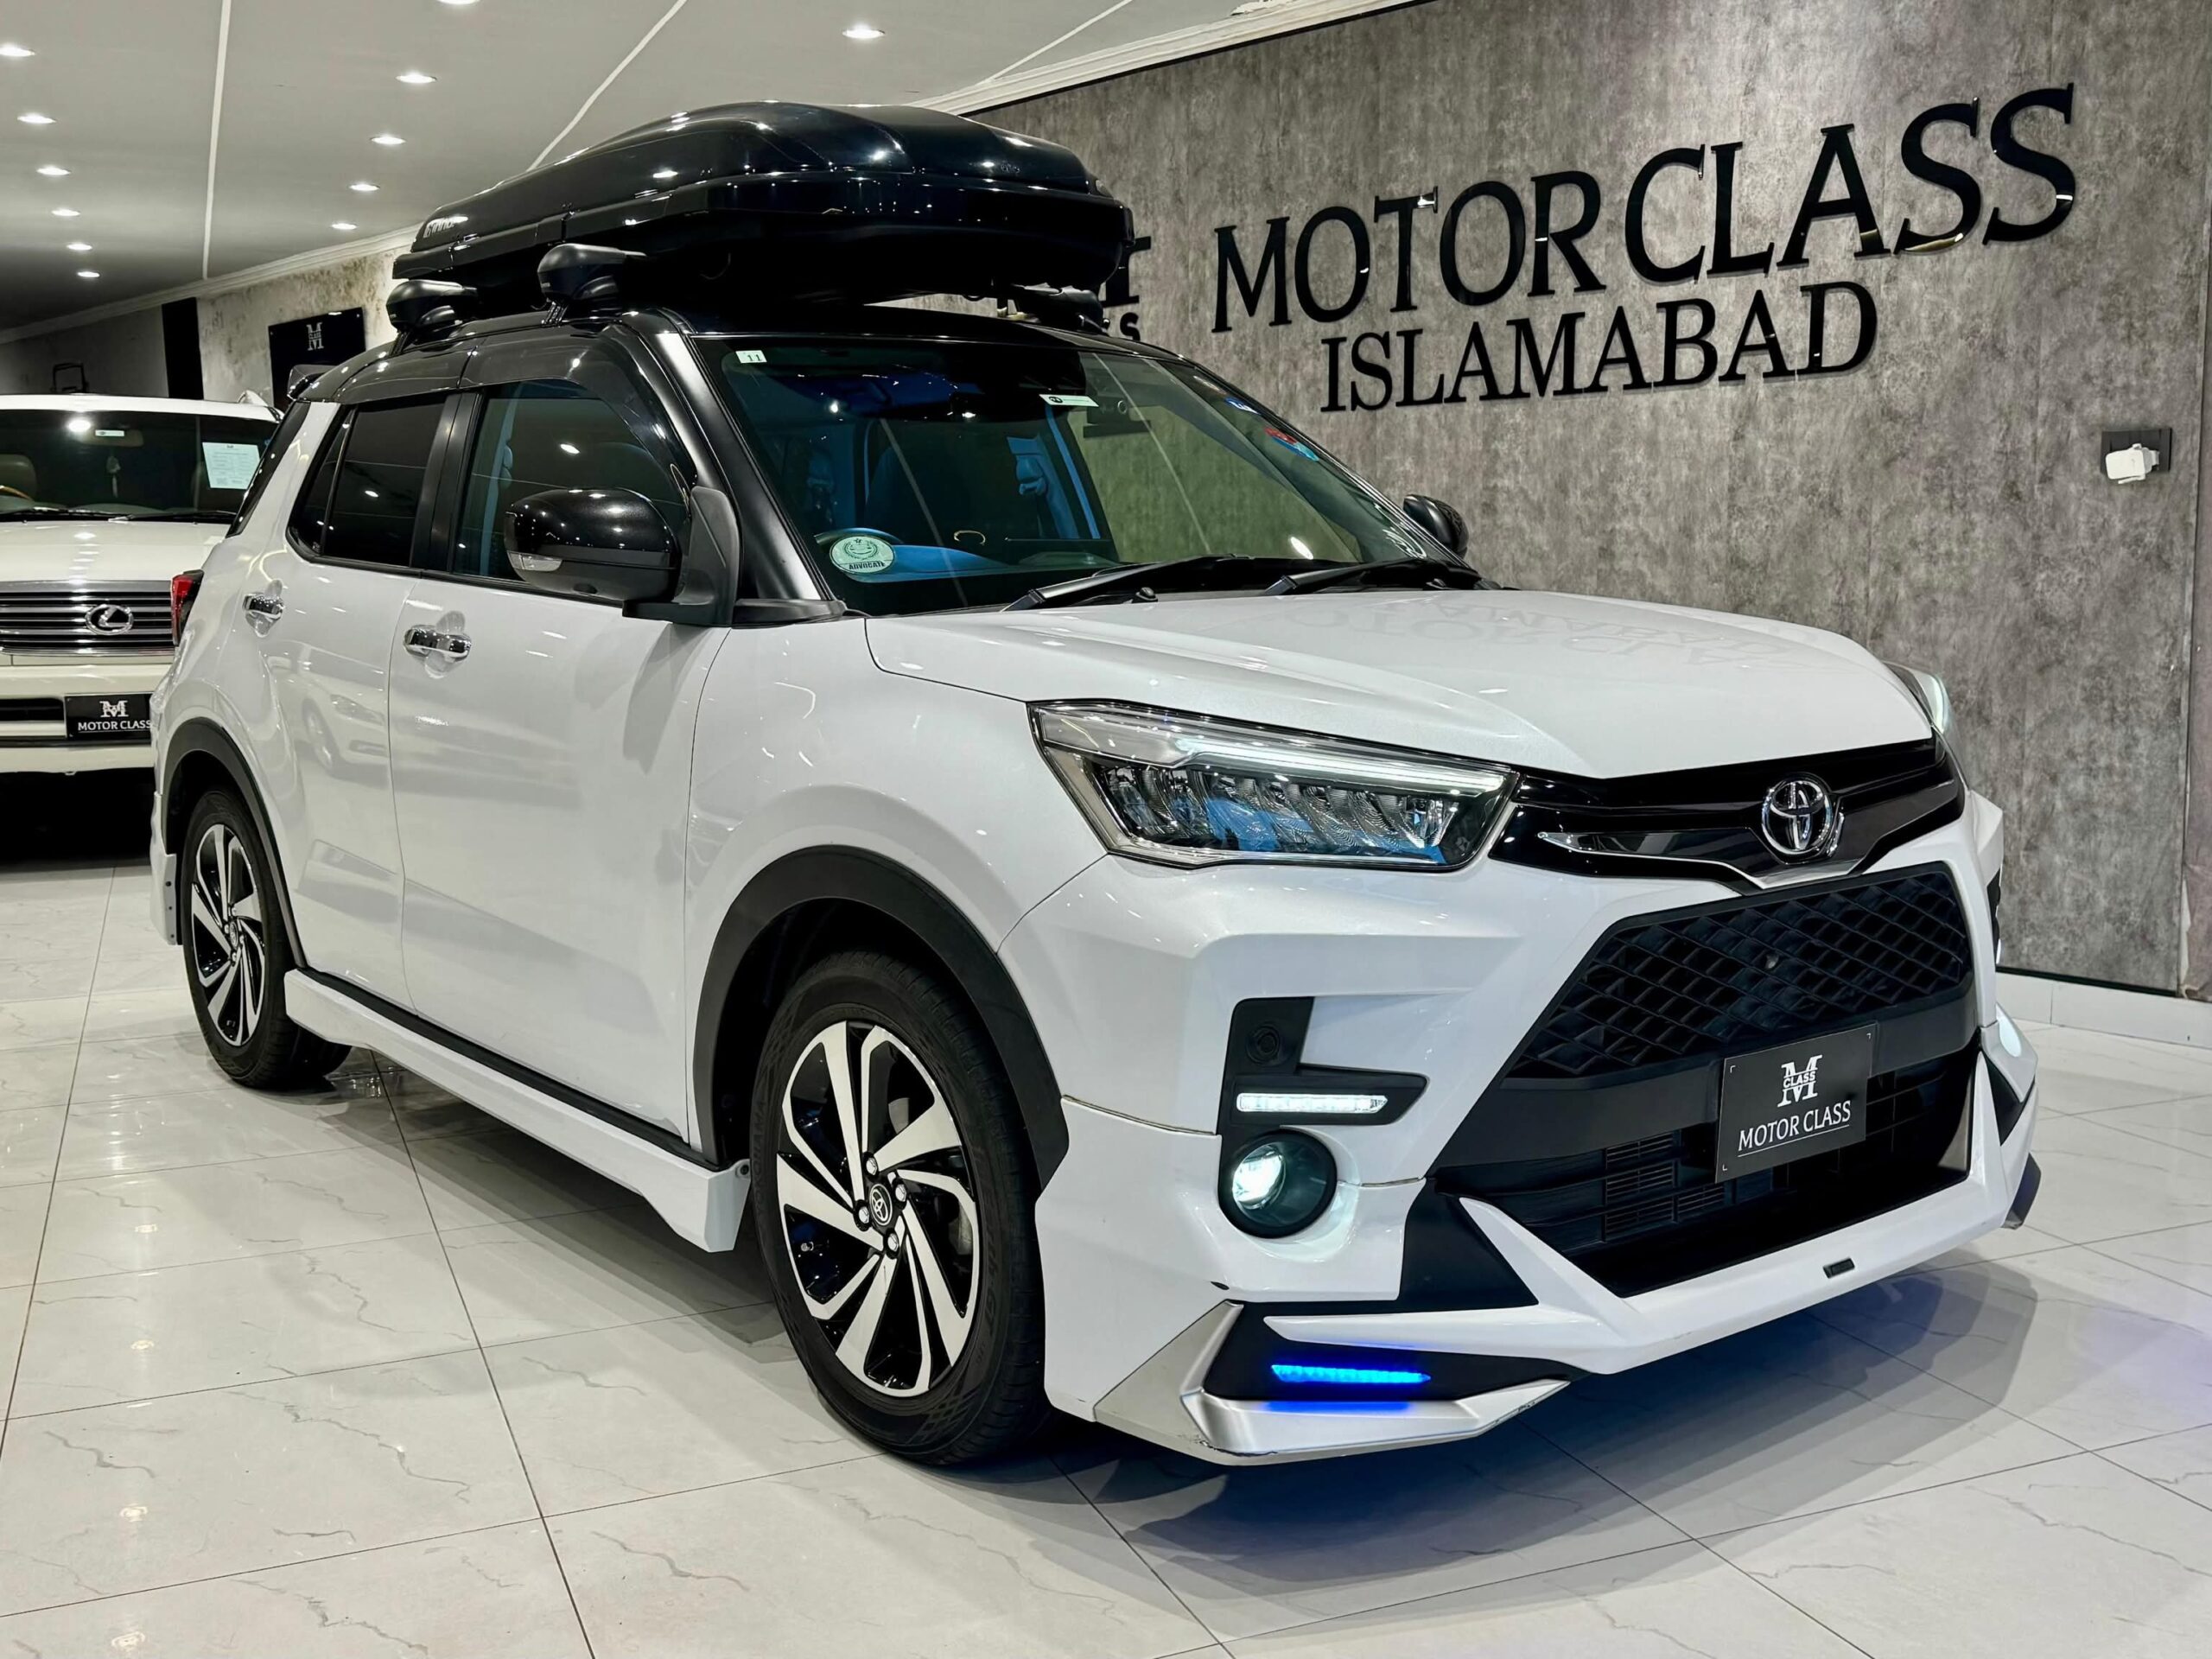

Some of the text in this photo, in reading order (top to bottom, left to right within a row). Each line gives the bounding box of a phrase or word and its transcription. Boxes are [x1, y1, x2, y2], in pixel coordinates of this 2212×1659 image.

[1211, 170, 1606, 334] MOTOR
[1624, 82, 2075, 283] CLASS
[1320, 281, 1878, 413] ISLAMABAD
[78, 719, 151, 731] MOTOR CLASS
[1783, 1071, 1816, 1089] CLASS
[1738, 1099, 1852, 1152] MOTOR CLASS
